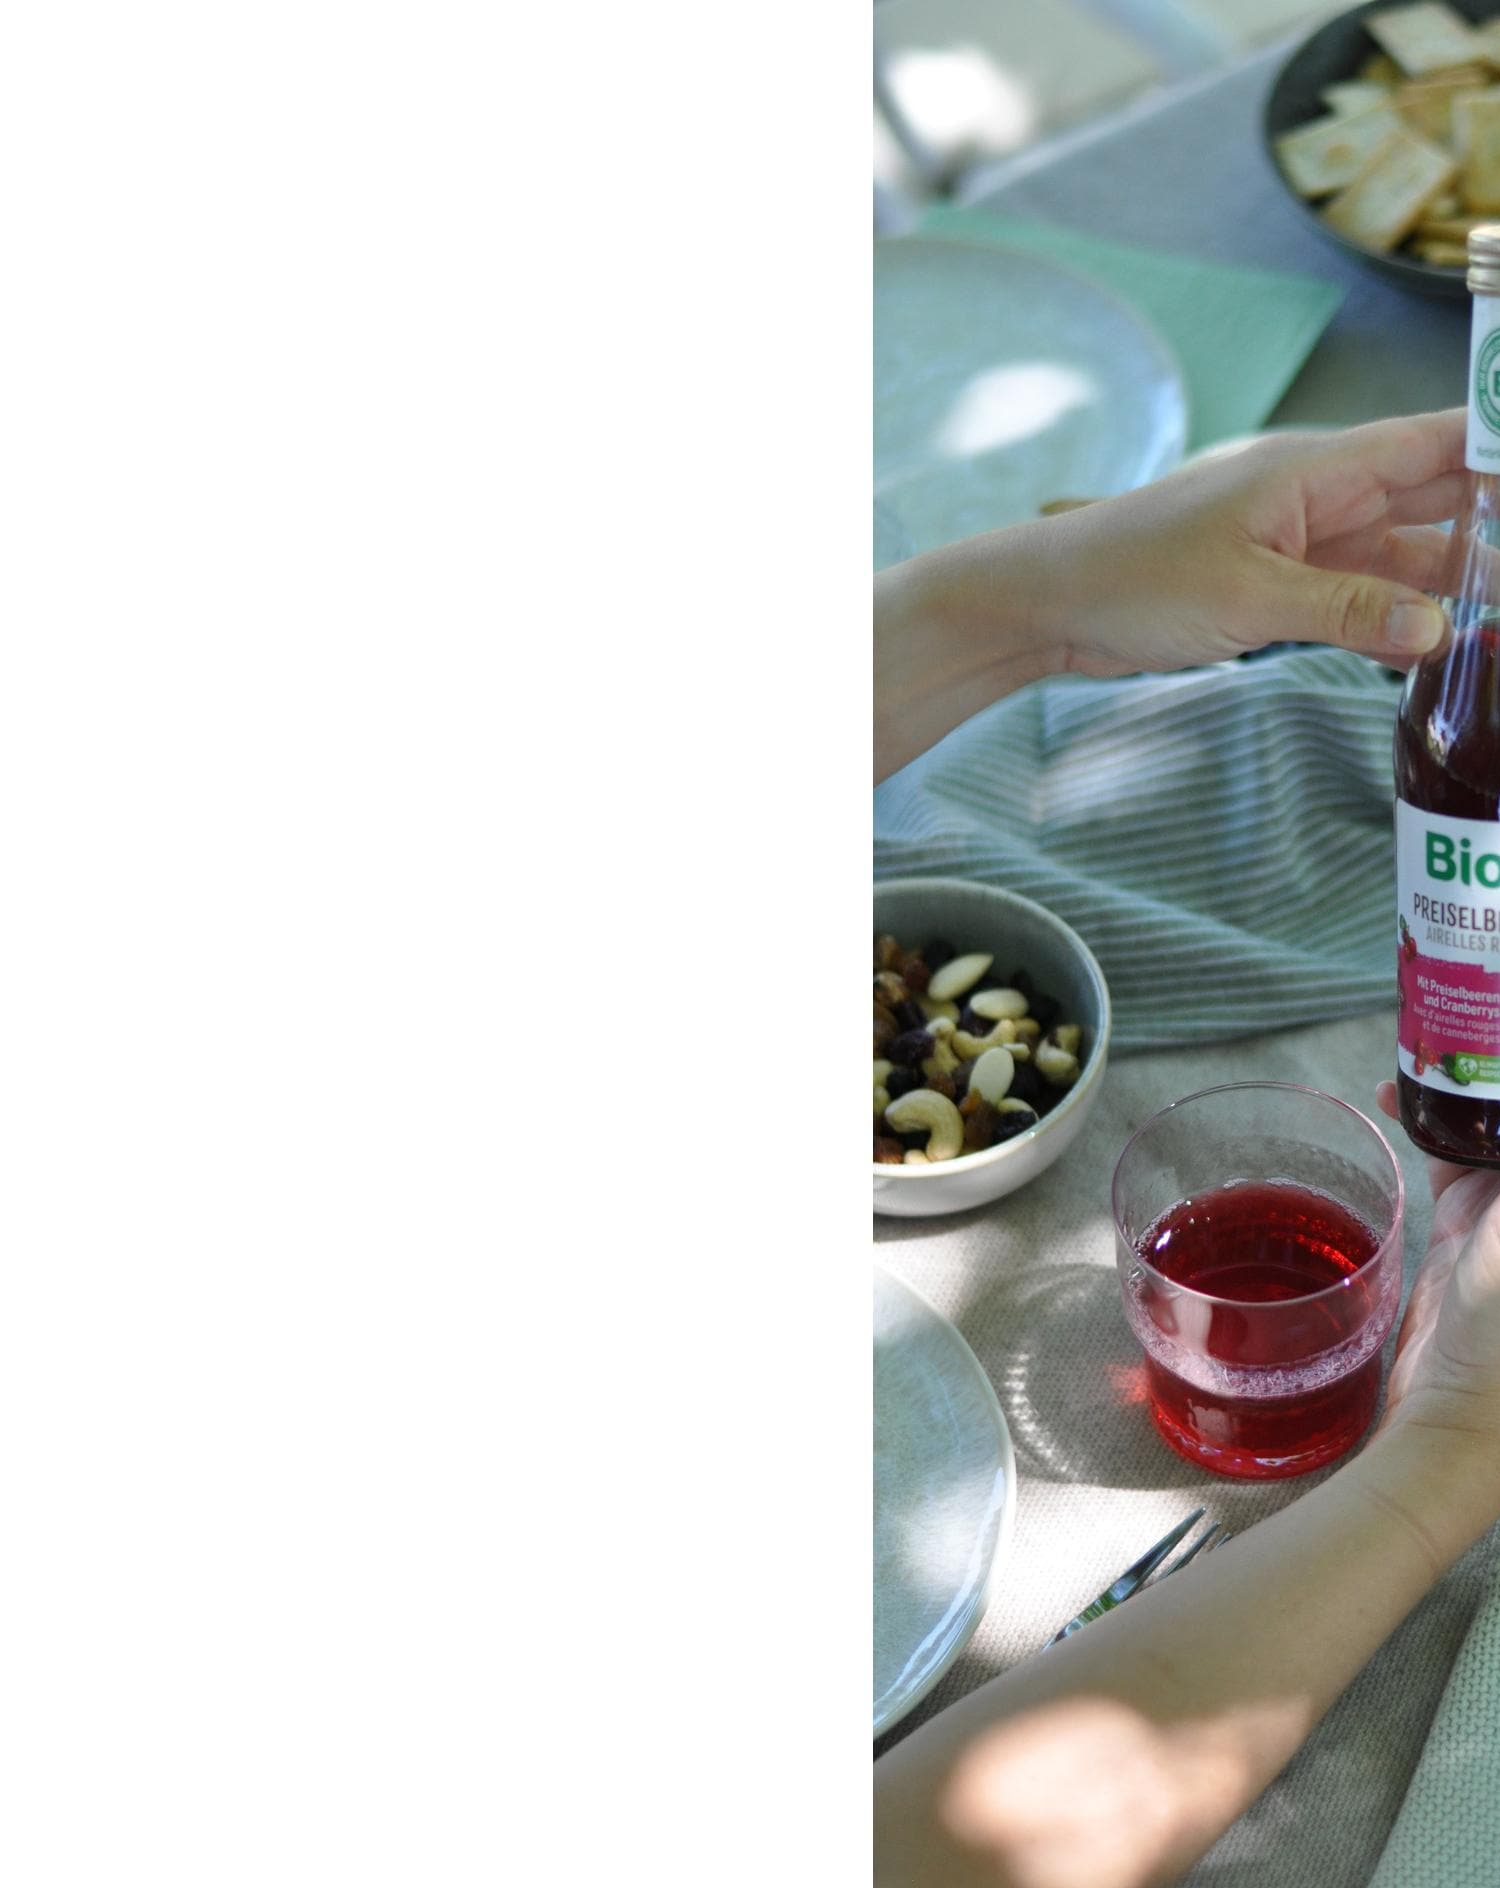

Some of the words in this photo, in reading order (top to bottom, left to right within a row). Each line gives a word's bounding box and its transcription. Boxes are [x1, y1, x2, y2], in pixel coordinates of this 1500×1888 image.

[1426, 926, 1487, 952] AIRELLES
[1417, 975, 1429, 991] Mit
[1430, 979, 1500, 1003] Preiselbeeren
[1423, 994, 1440, 1008] und
[1440, 996, 1500, 1020] Cranberrys
[1442, 1027, 1500, 1046] canneberges
[1466, 1019, 1500, 1033] rouges
